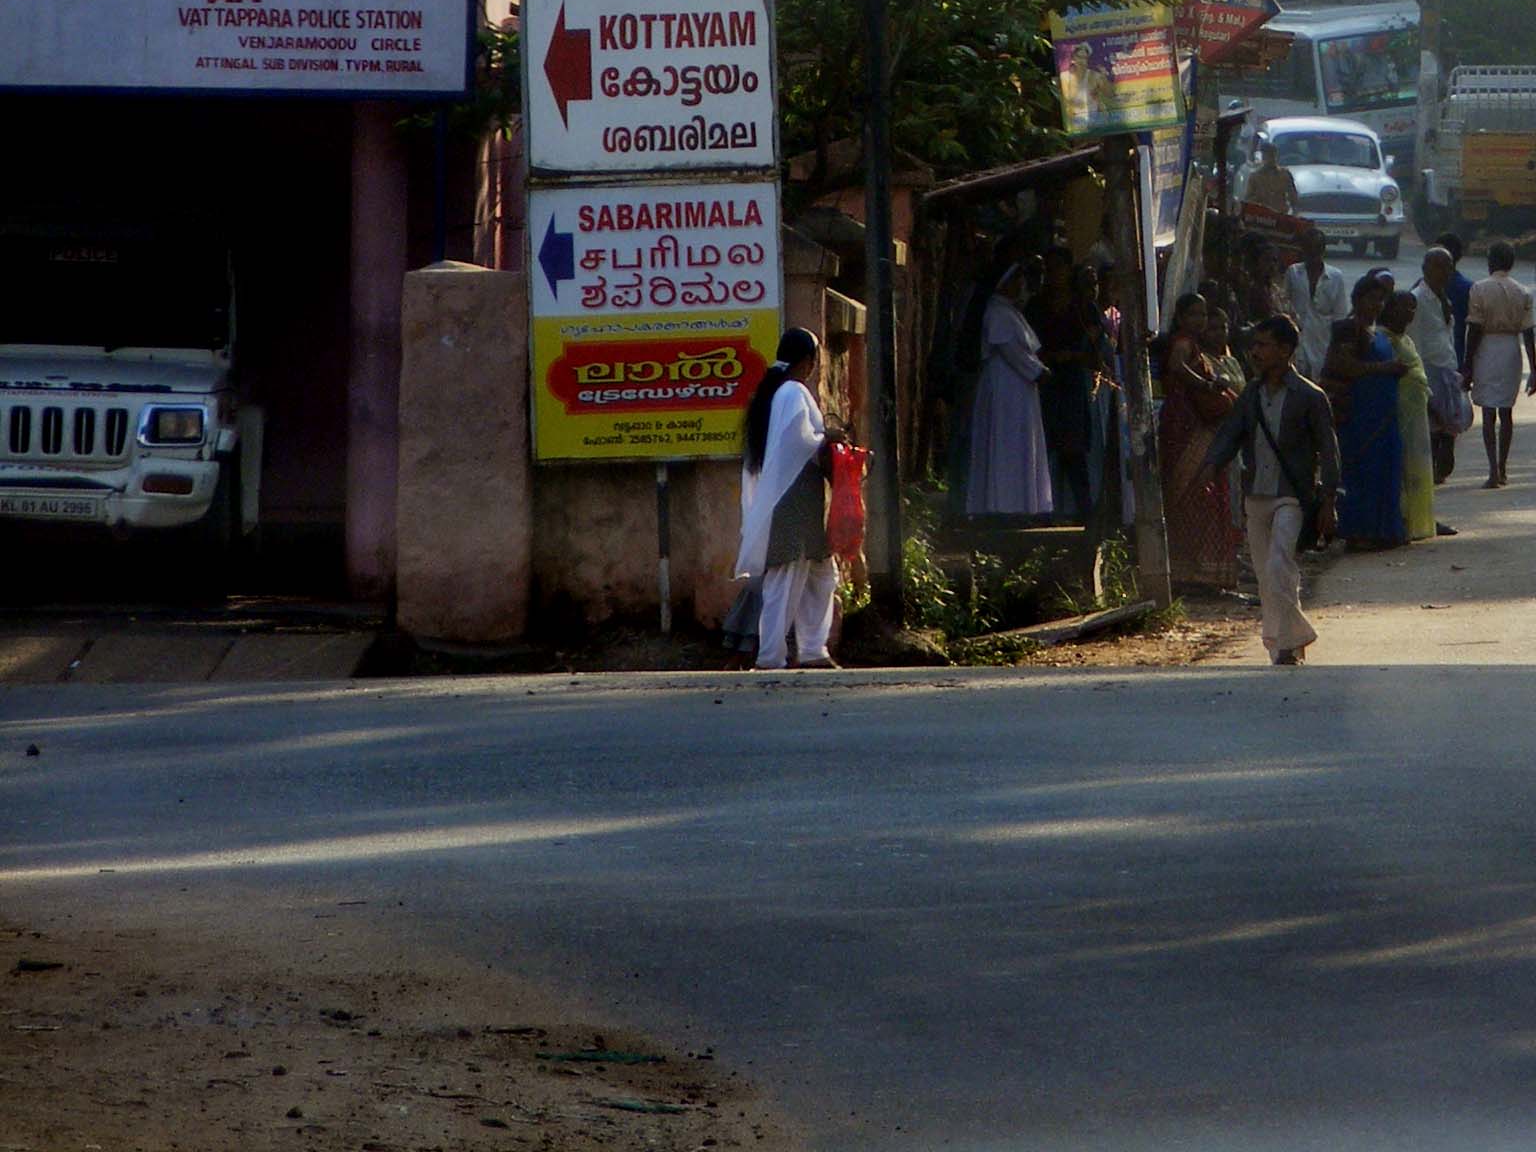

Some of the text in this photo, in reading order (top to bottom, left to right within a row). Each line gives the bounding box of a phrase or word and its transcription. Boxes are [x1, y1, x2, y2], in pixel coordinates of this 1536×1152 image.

[298, 10, 351, 29] POLICE
[356, 10, 423, 29] STATION
[599, 10, 757, 51] KOTTAYAM
[238, 35, 422, 51] VENJARAMOODU CIRCLE
[195, 56, 258, 70] ATTINGAL
[263, 58, 285, 70] SUB
[385, 60, 424, 72] RURAL
[600, 64, 759, 107] കോട്ടയം
[602, 114, 758, 153] ശബരിമല
[578, 199, 763, 233] SABARIMALA
